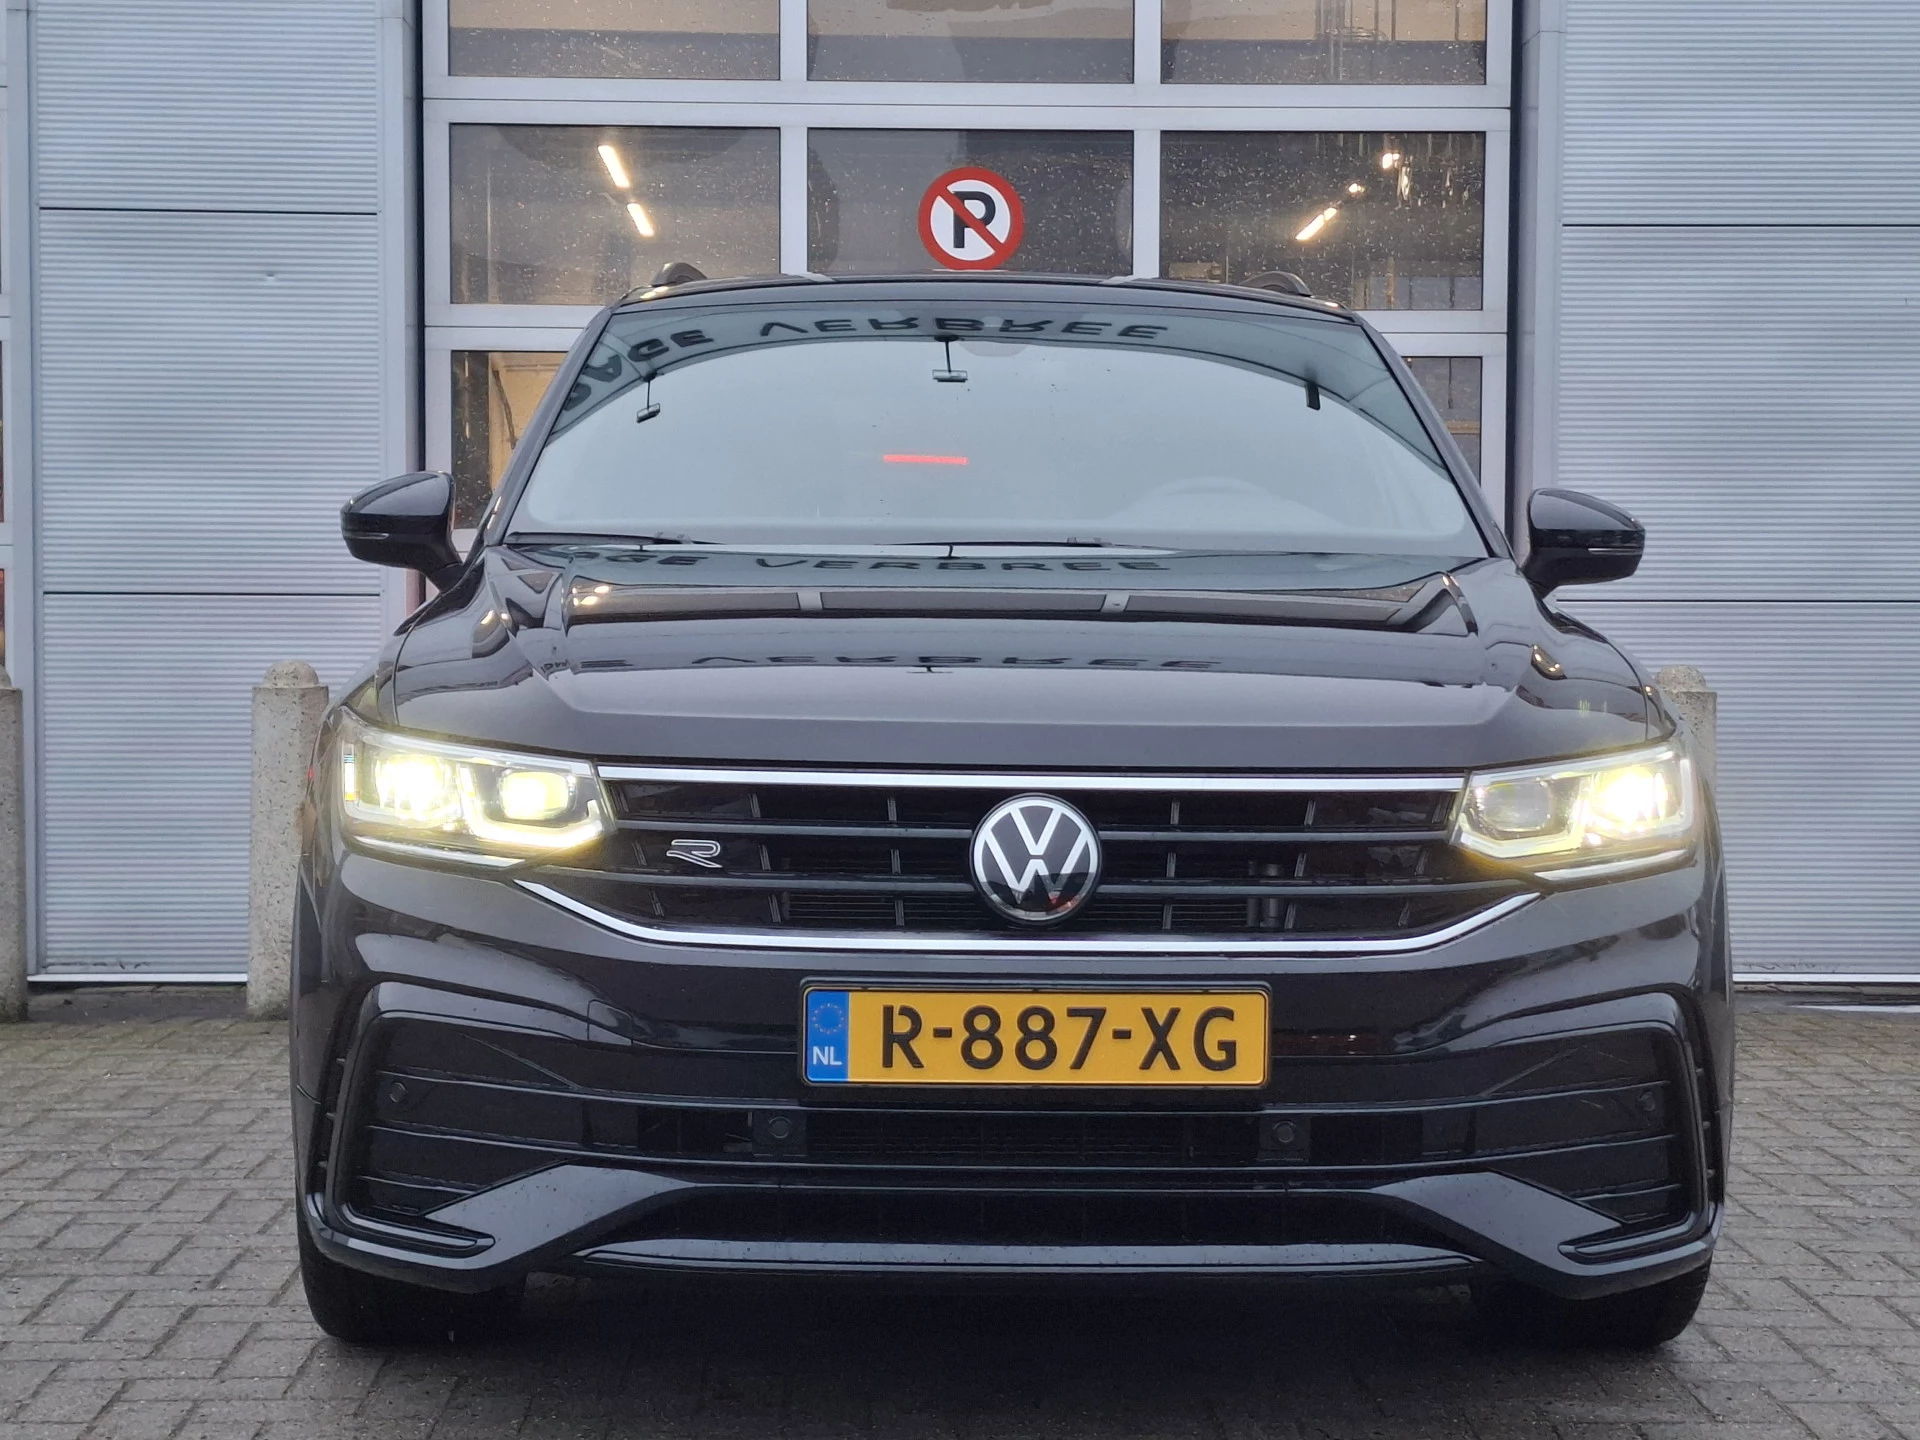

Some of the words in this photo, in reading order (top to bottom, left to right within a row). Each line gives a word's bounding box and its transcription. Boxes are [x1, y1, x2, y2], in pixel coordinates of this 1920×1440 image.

[953, 191, 996, 249] P
[756, 558, 1170, 572] VERBREE
[976, 800, 1095, 916] VW
[812, 1045, 842, 1067] NL
[881, 1004, 1238, 1071] R-887-XG
